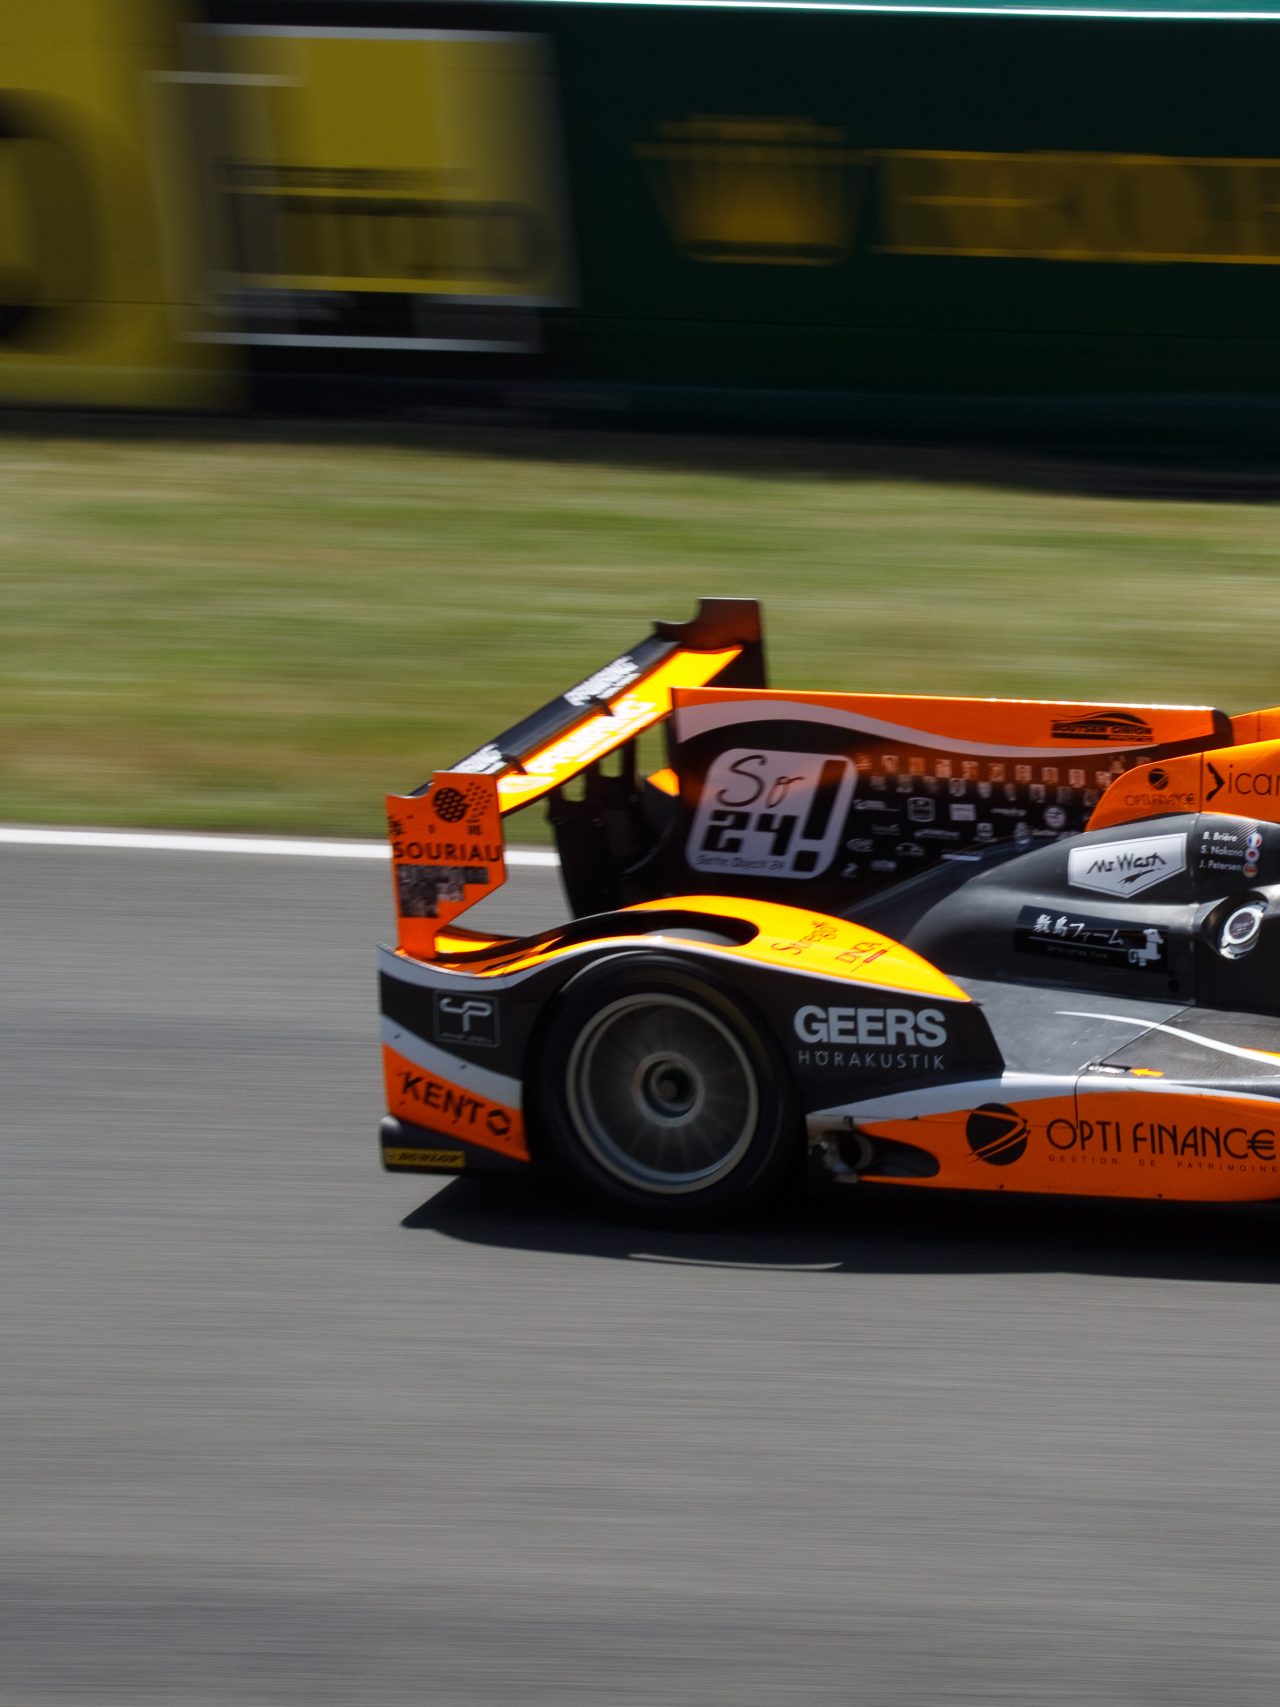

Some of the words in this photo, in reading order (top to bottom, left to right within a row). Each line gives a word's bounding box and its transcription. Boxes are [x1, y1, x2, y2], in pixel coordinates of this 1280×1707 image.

[392, 841, 503, 862] SOURIAU
[793, 1005, 948, 1048] GEERS
[797, 1049, 946, 1071] HÖRAKUSTIK
[401, 1071, 511, 1137] KENTO
[1046, 1119, 1122, 1152] OPTI
